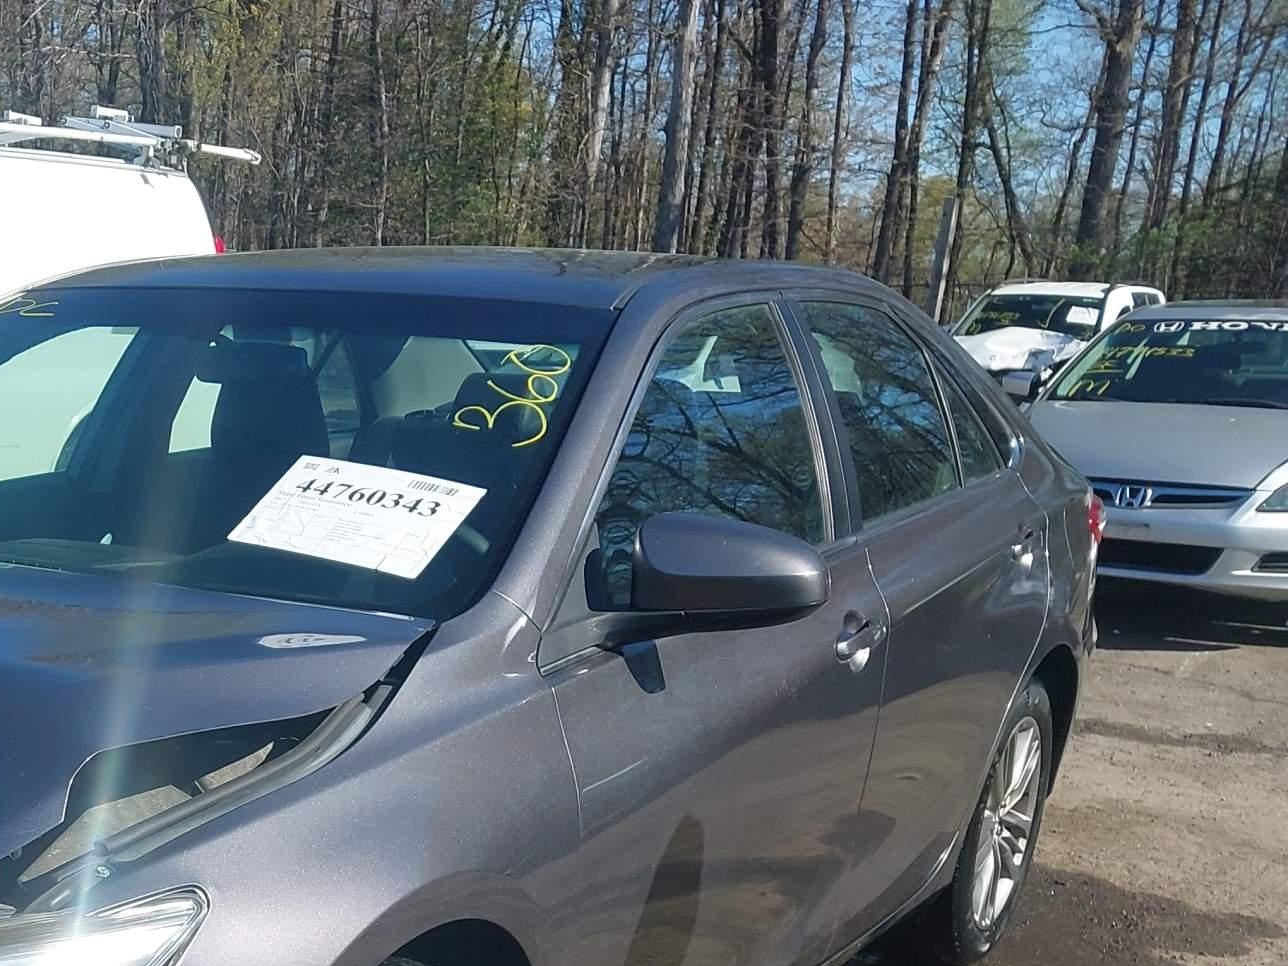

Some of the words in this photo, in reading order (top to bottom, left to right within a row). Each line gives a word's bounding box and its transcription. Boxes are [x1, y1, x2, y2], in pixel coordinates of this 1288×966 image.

[1189, 320, 1288, 332] HON
[452, 344, 571, 447] 360
[295, 478, 442, 517] 44760343
